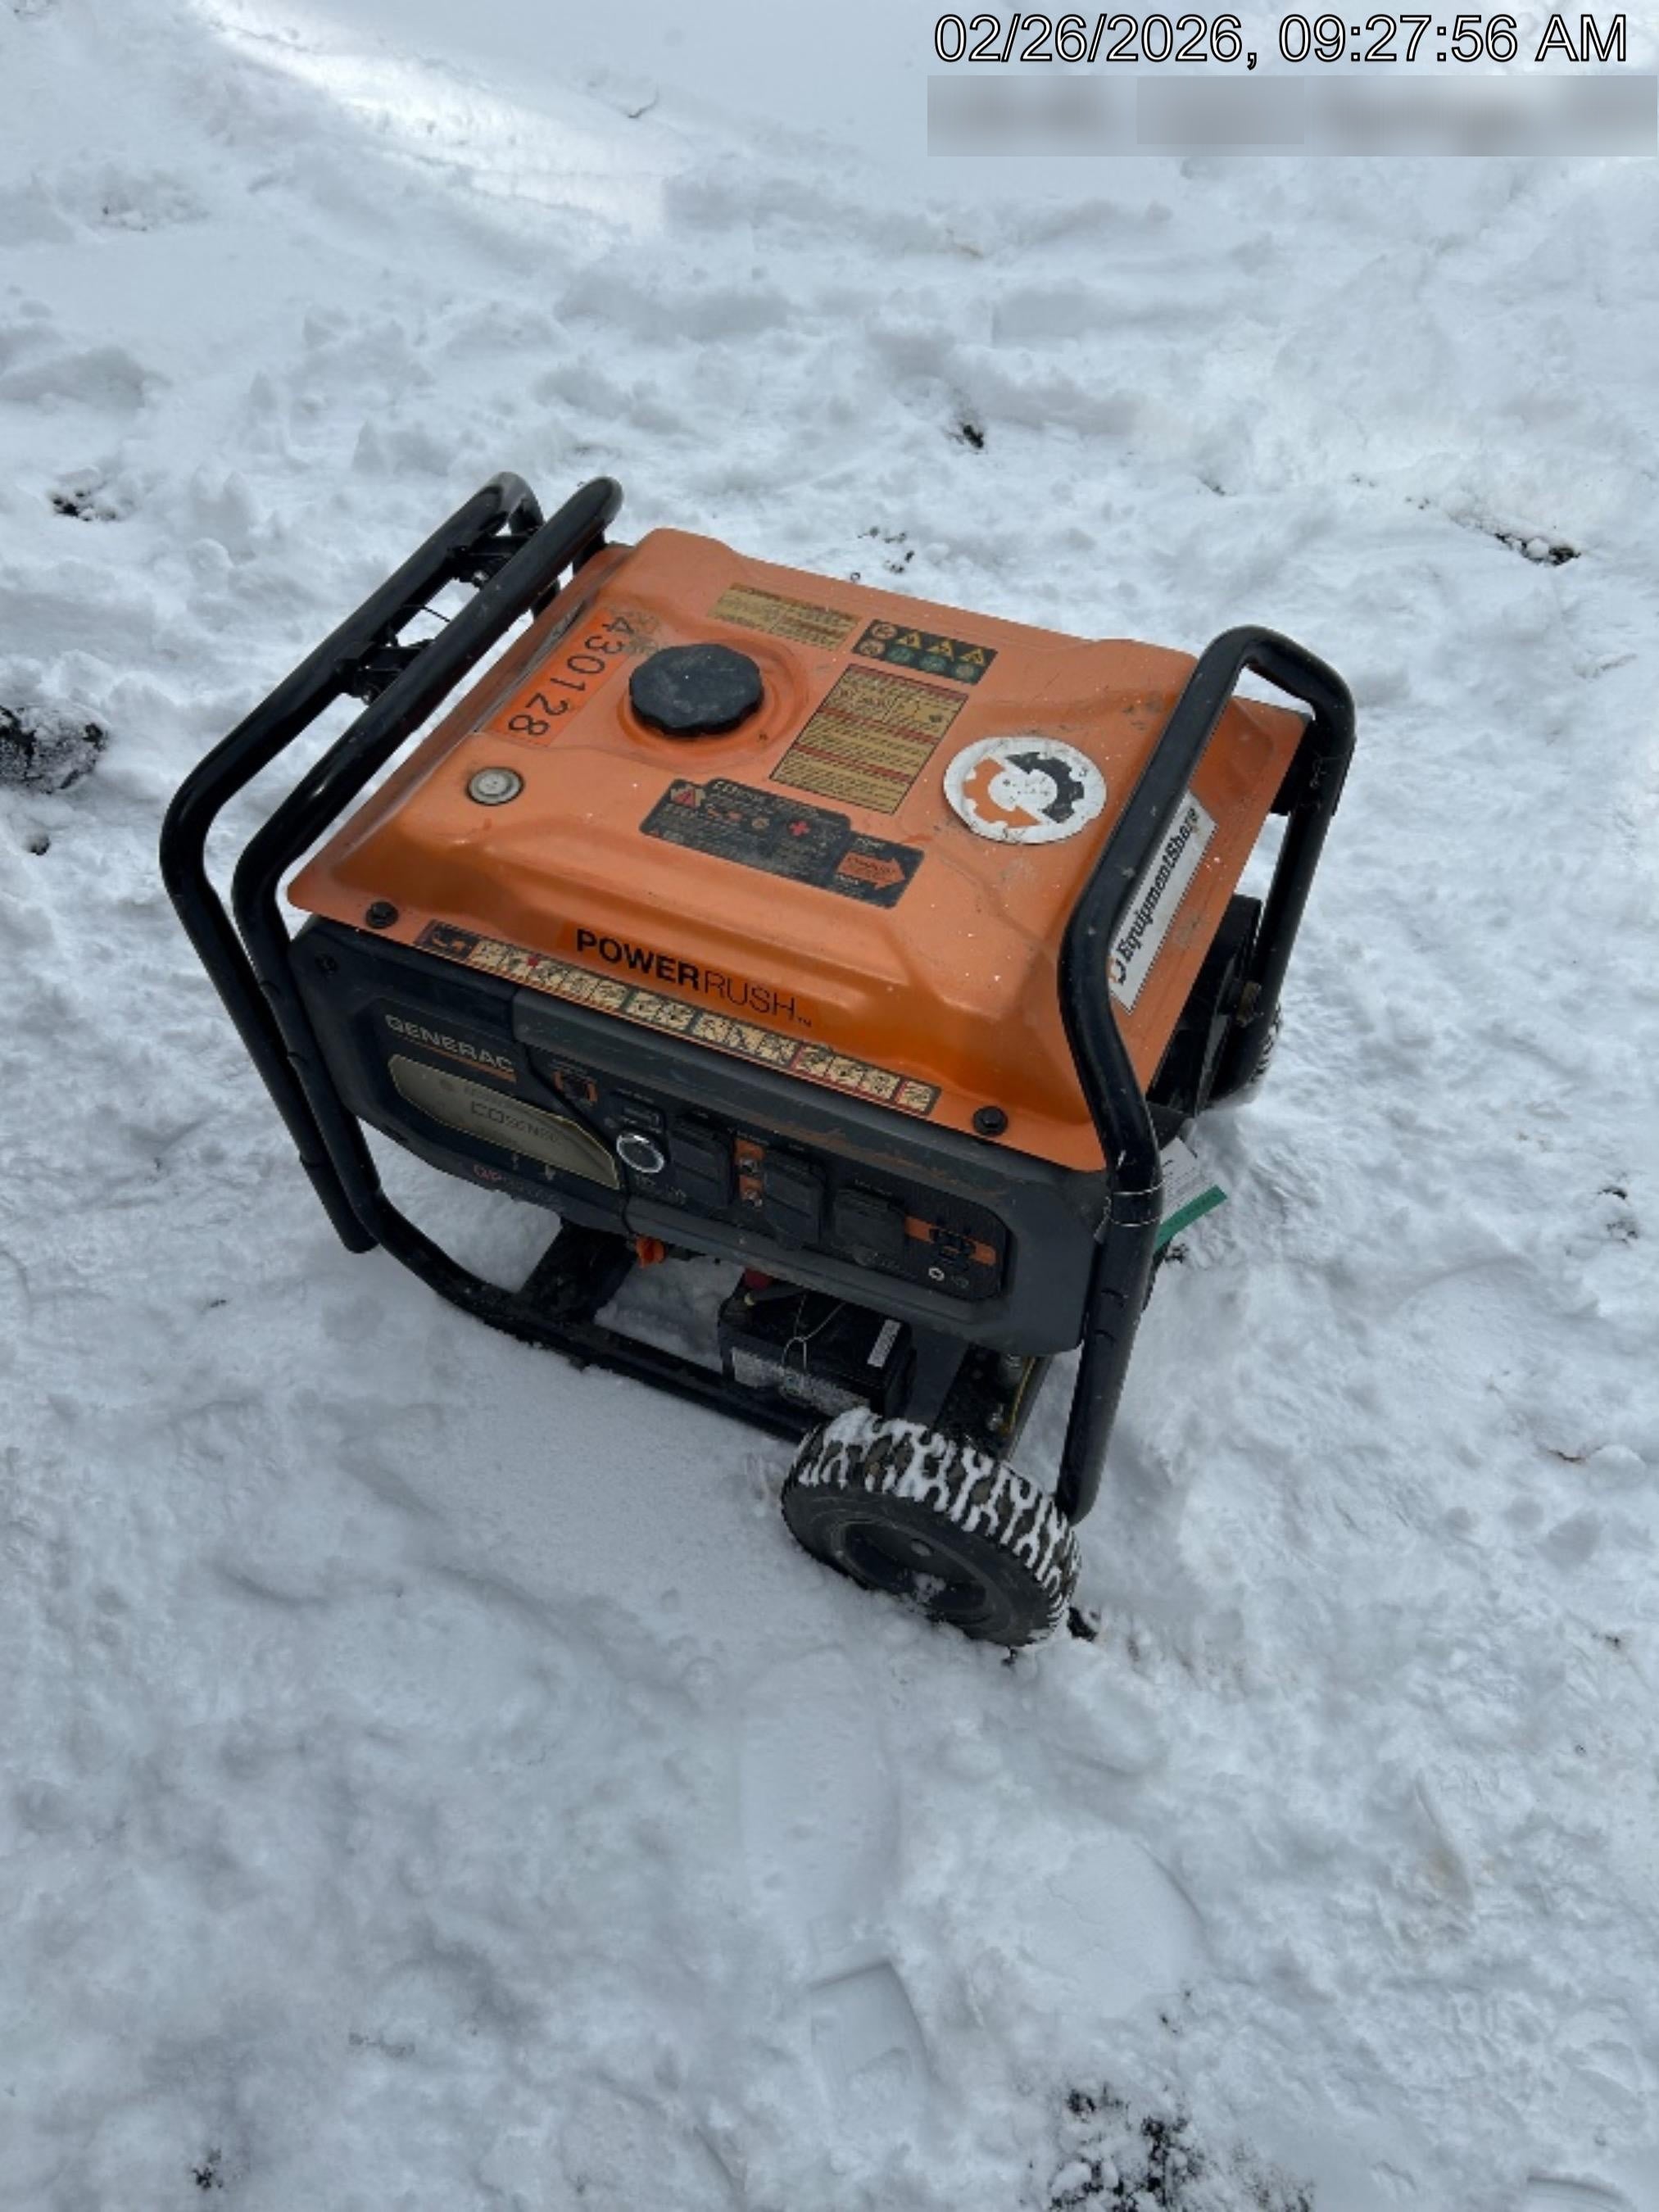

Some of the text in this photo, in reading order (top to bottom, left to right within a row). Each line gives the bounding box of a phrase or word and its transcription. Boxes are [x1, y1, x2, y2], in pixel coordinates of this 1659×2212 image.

[508, 616, 635, 736] 430128
[1116, 807, 1200, 963] EquipmentShare
[385, 1013, 515, 1073] GENERAC
